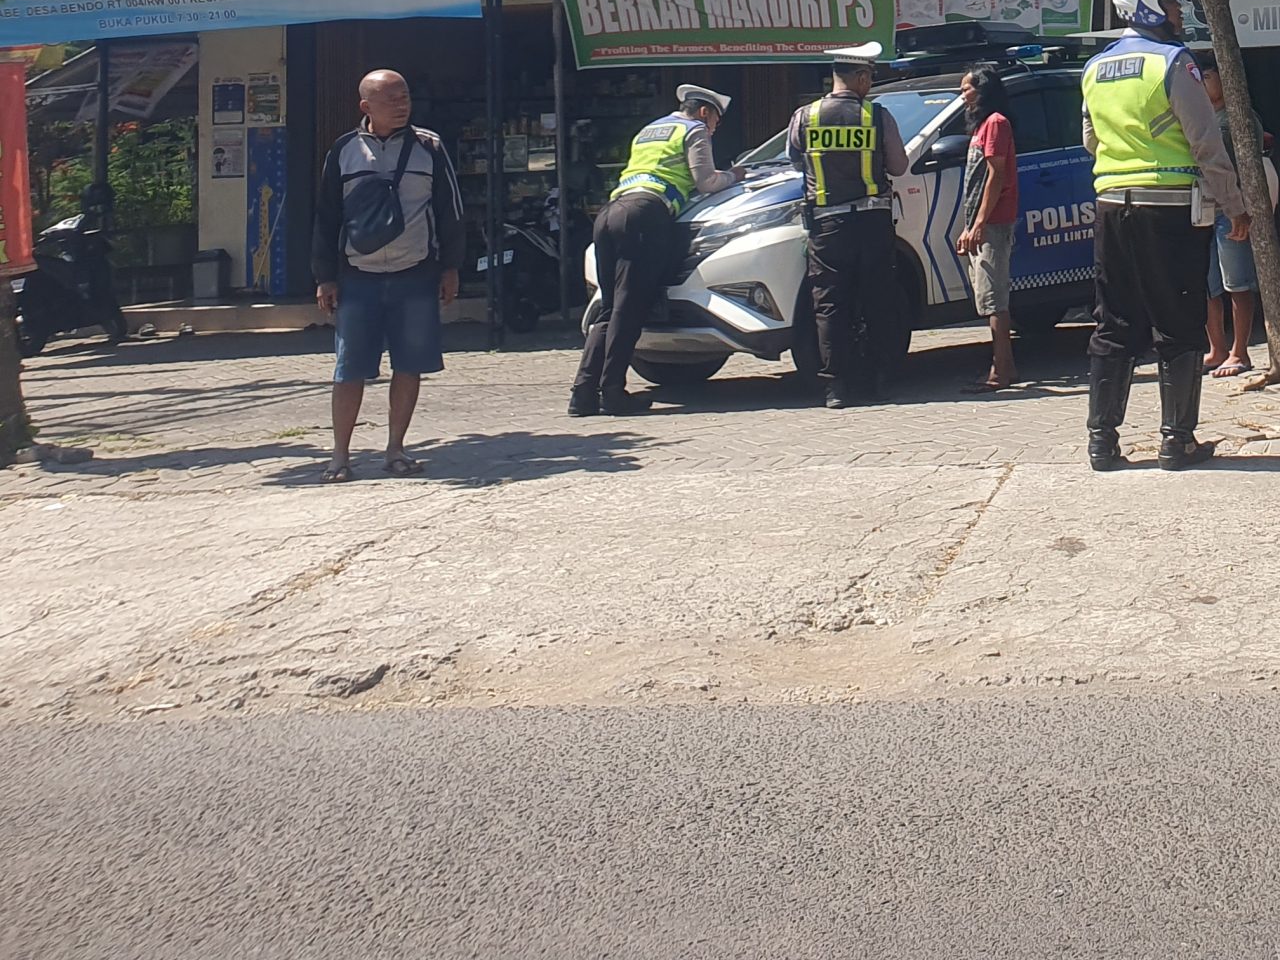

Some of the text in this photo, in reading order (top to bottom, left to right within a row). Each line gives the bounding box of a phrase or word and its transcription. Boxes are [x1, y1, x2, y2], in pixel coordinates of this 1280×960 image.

[26, 5, 58, 16] DESA
[61, 1, 104, 14] BENDO
[108, 0, 122, 9] RT
[100, 16, 132, 29] BUKA
[136, 14, 175, 26] PUKUL
[649, 44, 670, 53] The
[720, 43, 773, 53] Benefiting
[774, 43, 795, 52] The
[1097, 59, 1141, 78] POLISI
[809, 128, 872, 148] POLISI
[1033, 233, 1060, 248] LALU
